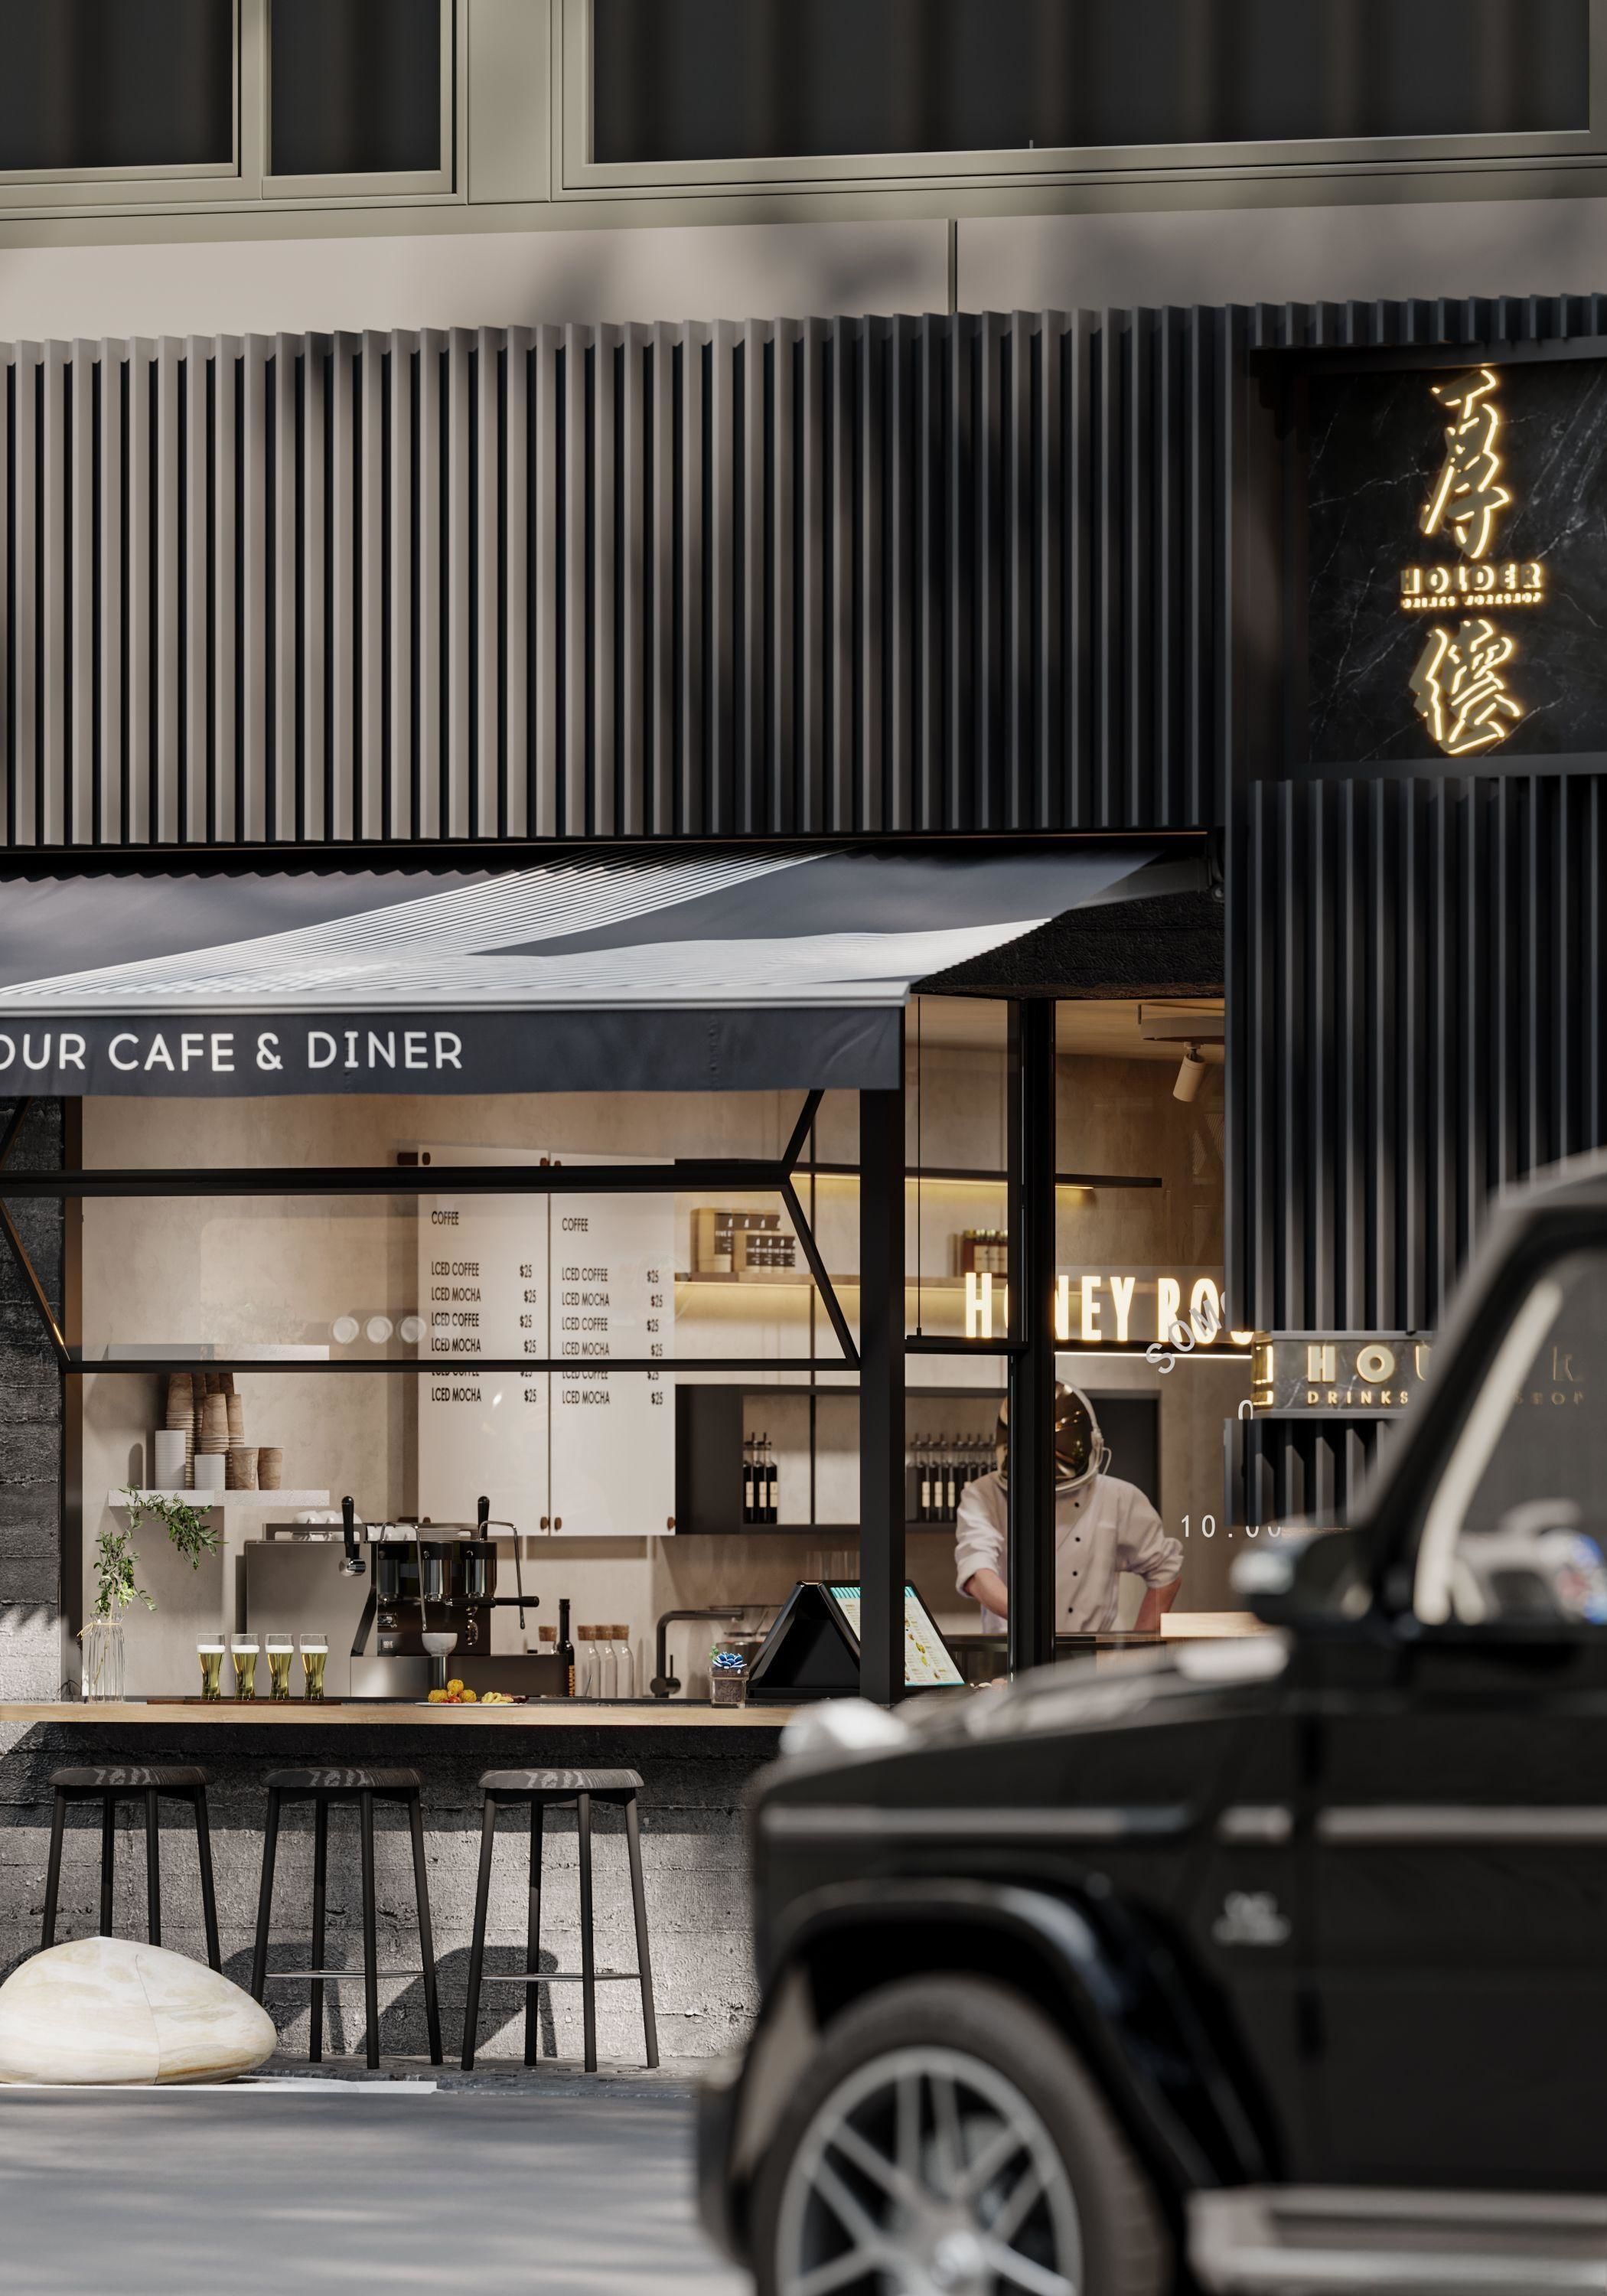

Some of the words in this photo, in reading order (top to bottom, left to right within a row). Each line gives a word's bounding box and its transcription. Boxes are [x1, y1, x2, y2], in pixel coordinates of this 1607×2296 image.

[109, 1033, 235, 1071] CAFE
[256, 1032, 283, 1070] &
[308, 1031, 463, 1068] DINER
[431, 1211, 459, 1225] COFFEE
[562, 1218, 588, 1232] COFFEE
[452, 1262, 479, 1277] COFFEE
[520, 1264, 532, 1278] $25
[582, 1267, 608, 1282] COFFEE
[647, 1269, 659, 1283] $25
[452, 1287, 481, 1302] MOCHA
[524, 1290, 536, 1303] $25
[582, 1293, 610, 1306] MOCHA
[651, 1294, 663, 1308] $25
[965, 1272, 1136, 1342] HNEY
[452, 1313, 479, 1327] COFFEE
[520, 1314, 532, 1329] $25
[582, 1317, 608, 1332] COFFEE
[647, 1319, 659, 1332] $25
[452, 1338, 481, 1352] MOCHA
[524, 1339, 536, 1353] $25
[582, 1342, 610, 1356] MOCHA
[651, 1343, 663, 1357] $25
[452, 1388, 481, 1402] MOCHA
[524, 1388, 536, 1403] $25
[582, 1391, 610, 1405] MOCHA
[651, 1391, 663, 1406] $25
[1307, 1390, 1409, 1405] DRINKS
